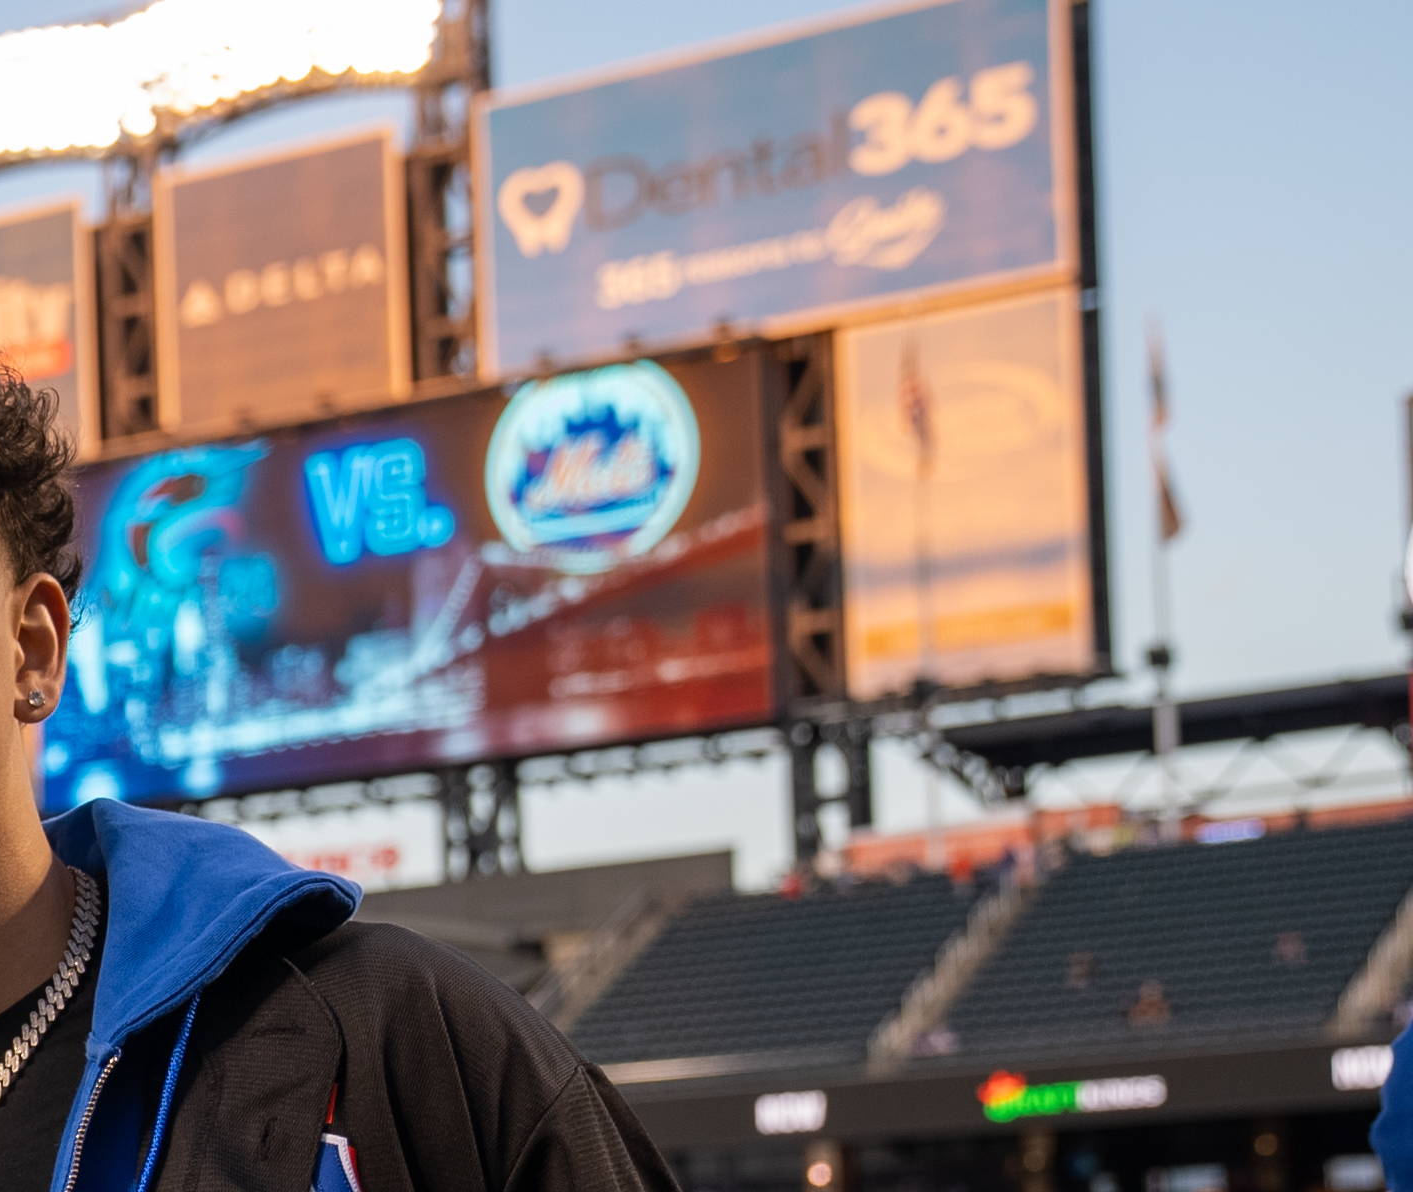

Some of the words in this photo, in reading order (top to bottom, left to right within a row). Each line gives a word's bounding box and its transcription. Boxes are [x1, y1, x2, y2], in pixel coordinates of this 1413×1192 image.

[581, 112, 859, 233] Dental
[847, 61, 1039, 177] 365
[224, 243, 387, 316] DELTA
